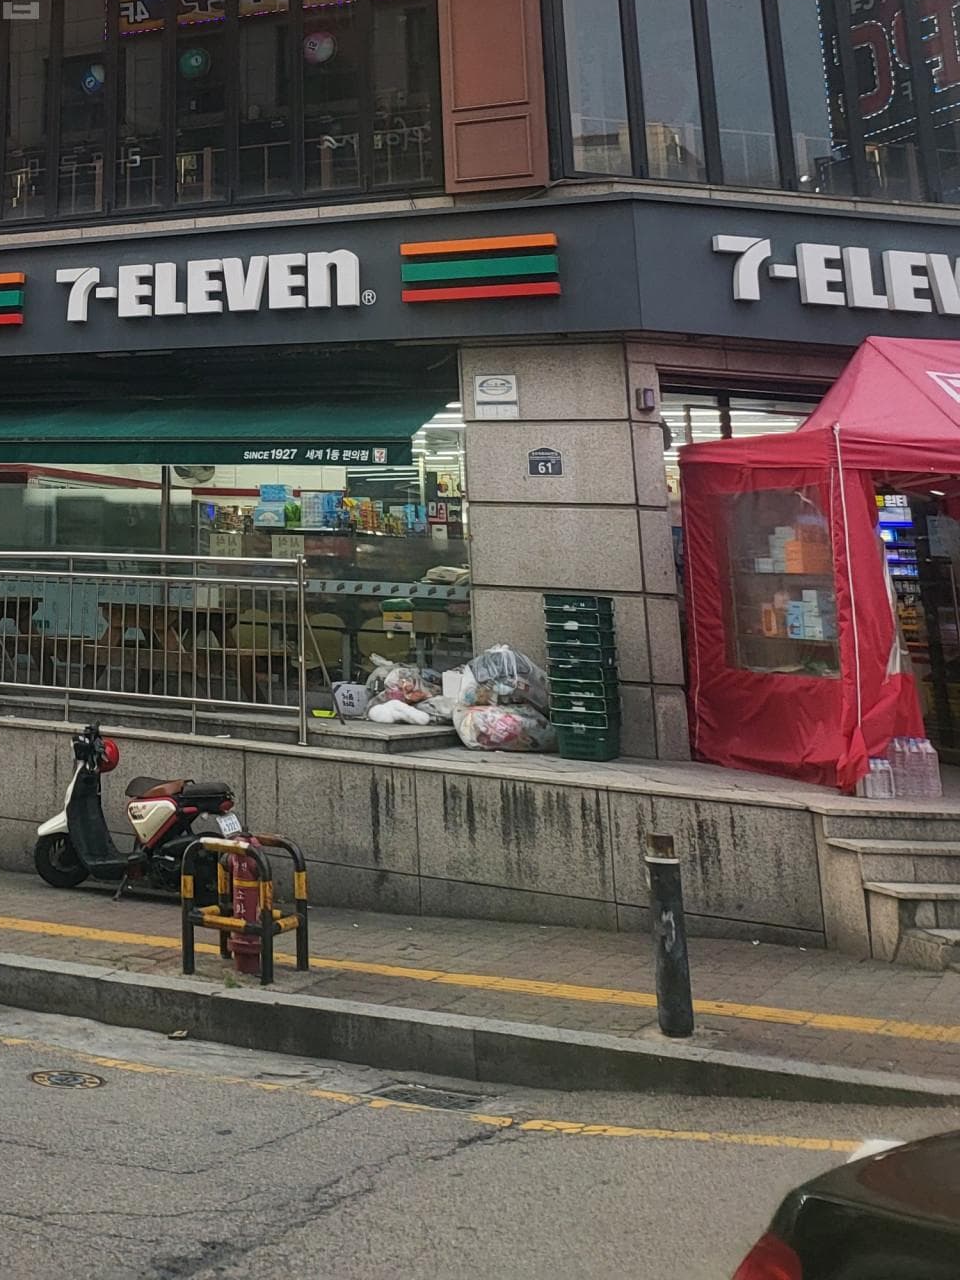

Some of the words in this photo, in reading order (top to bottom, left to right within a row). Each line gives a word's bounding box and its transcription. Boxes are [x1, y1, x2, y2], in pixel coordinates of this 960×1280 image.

[712, 234, 960, 314] 7-ELEV
[243, 450, 269, 459] SINCE
[270, 448, 297, 459] 1927
[305, 449, 323, 460] 세계
[326, 448, 340, 460] 1등
[342, 449, 369, 461] 편의점
[538, 462, 553, 473] 61
